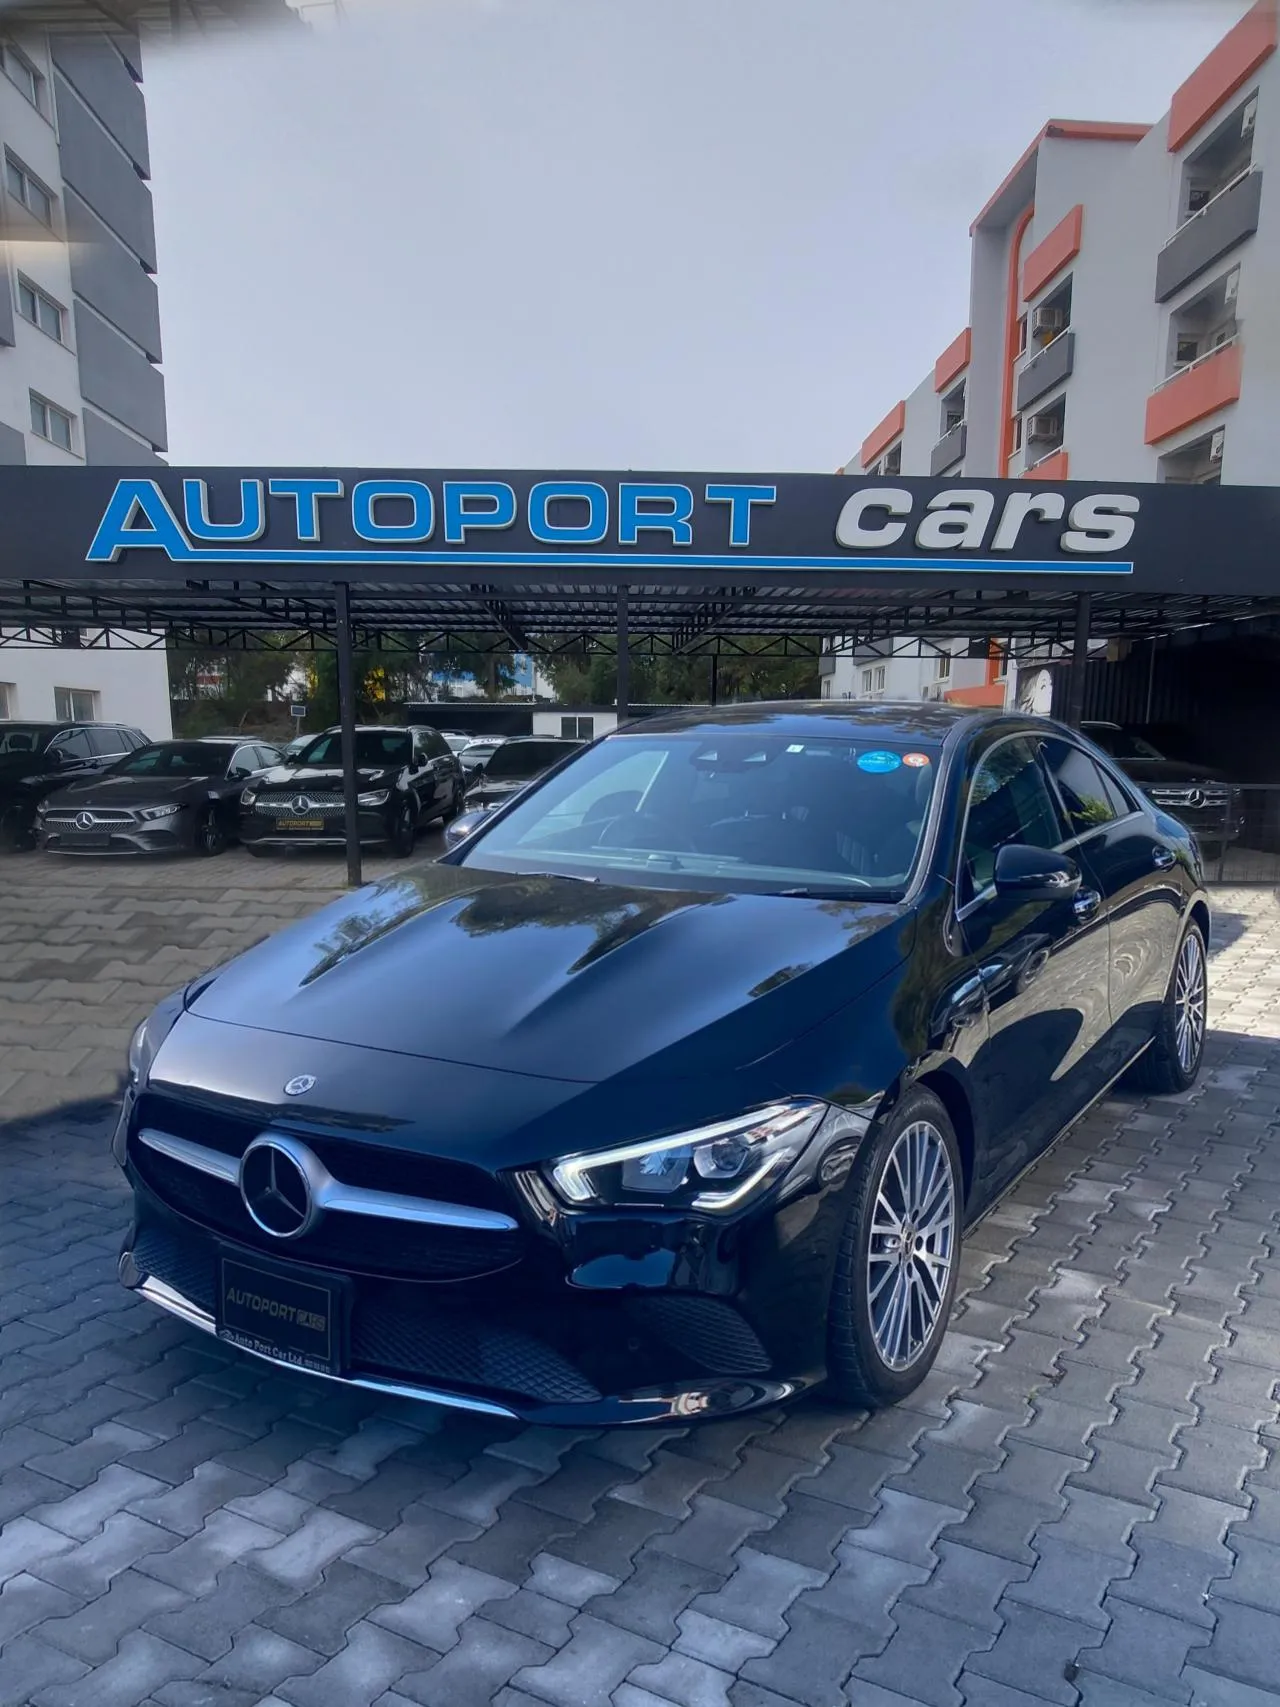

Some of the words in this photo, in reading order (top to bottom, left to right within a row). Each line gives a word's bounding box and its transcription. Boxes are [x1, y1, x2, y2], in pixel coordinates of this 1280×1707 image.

[85, 478, 778, 562] AUTOPORT
[835, 487, 1141, 554] cars
[226, 1287, 296, 1321] AUTOPORT
[235, 1334, 253, 1347] Auto
[272, 1347, 287, 1360] Car
